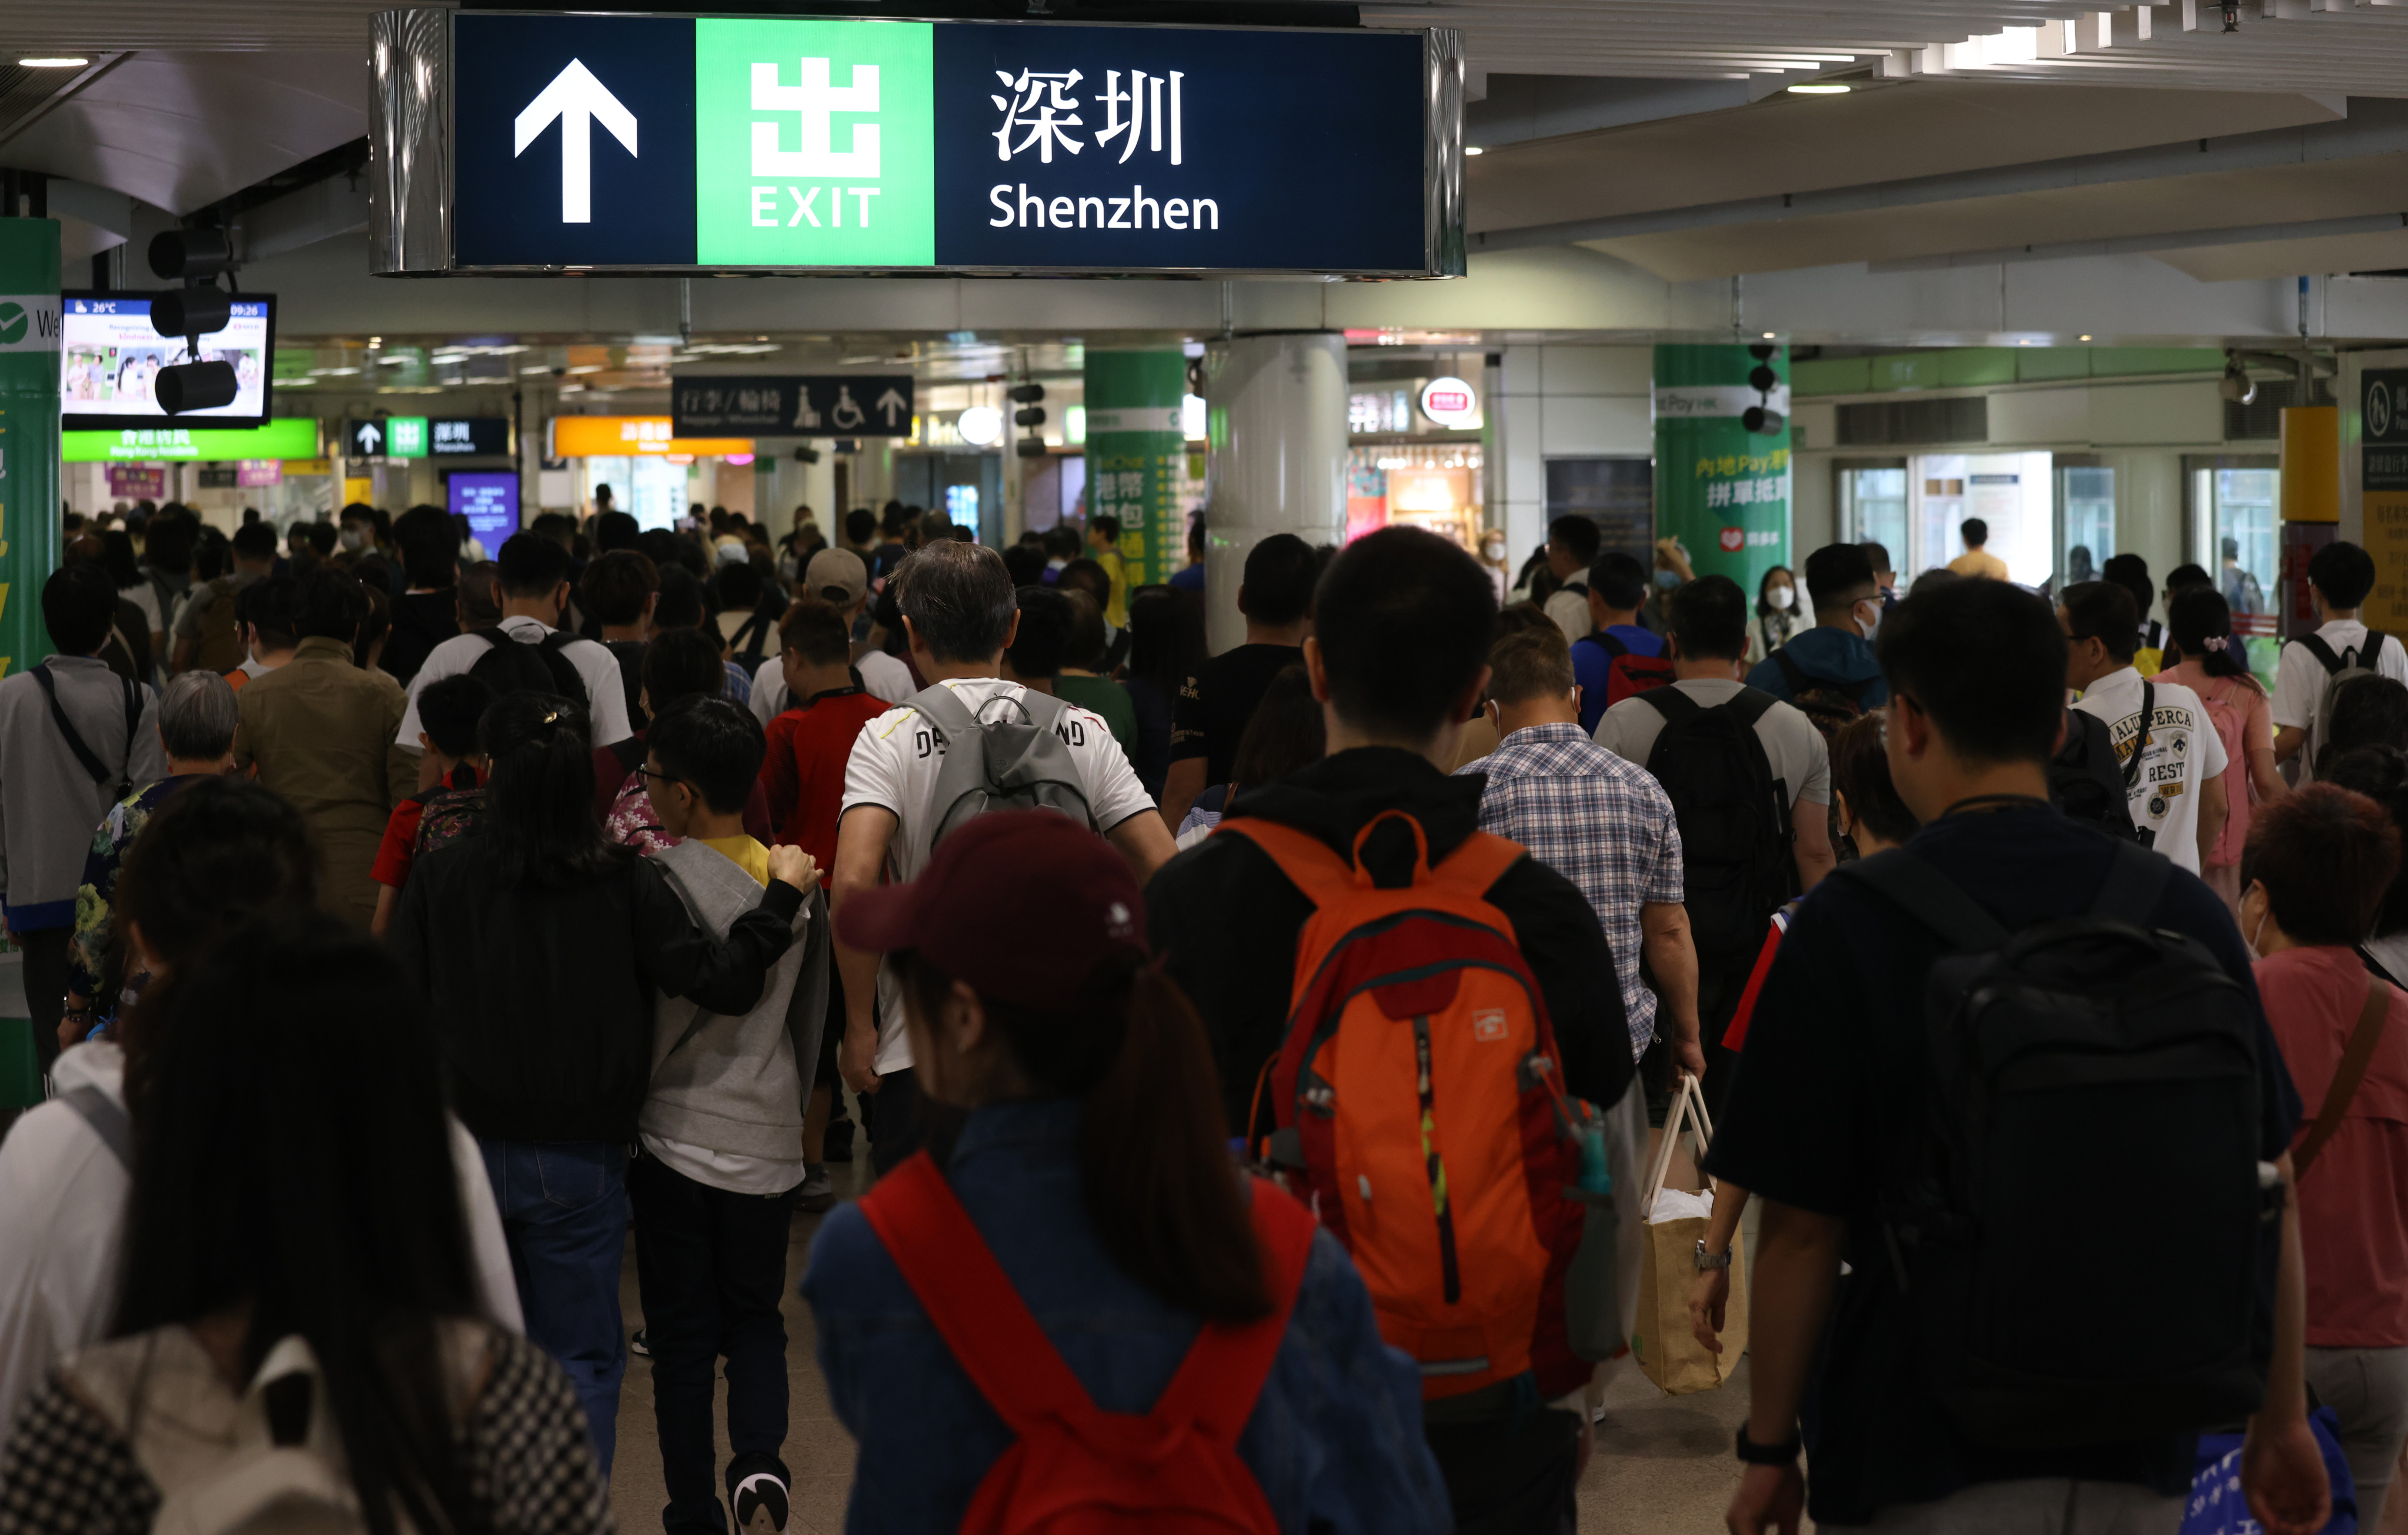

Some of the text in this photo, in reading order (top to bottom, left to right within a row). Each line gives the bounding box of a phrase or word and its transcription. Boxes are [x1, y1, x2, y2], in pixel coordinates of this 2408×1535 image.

[752, 58, 881, 178] 出
[991, 67, 1184, 165] 深圳
[752, 186, 881, 228] EXIT
[990, 183, 1219, 230] Shenzhen
[231, 305, 259, 318] 09:26
[2149, 762, 2185, 783] REST
